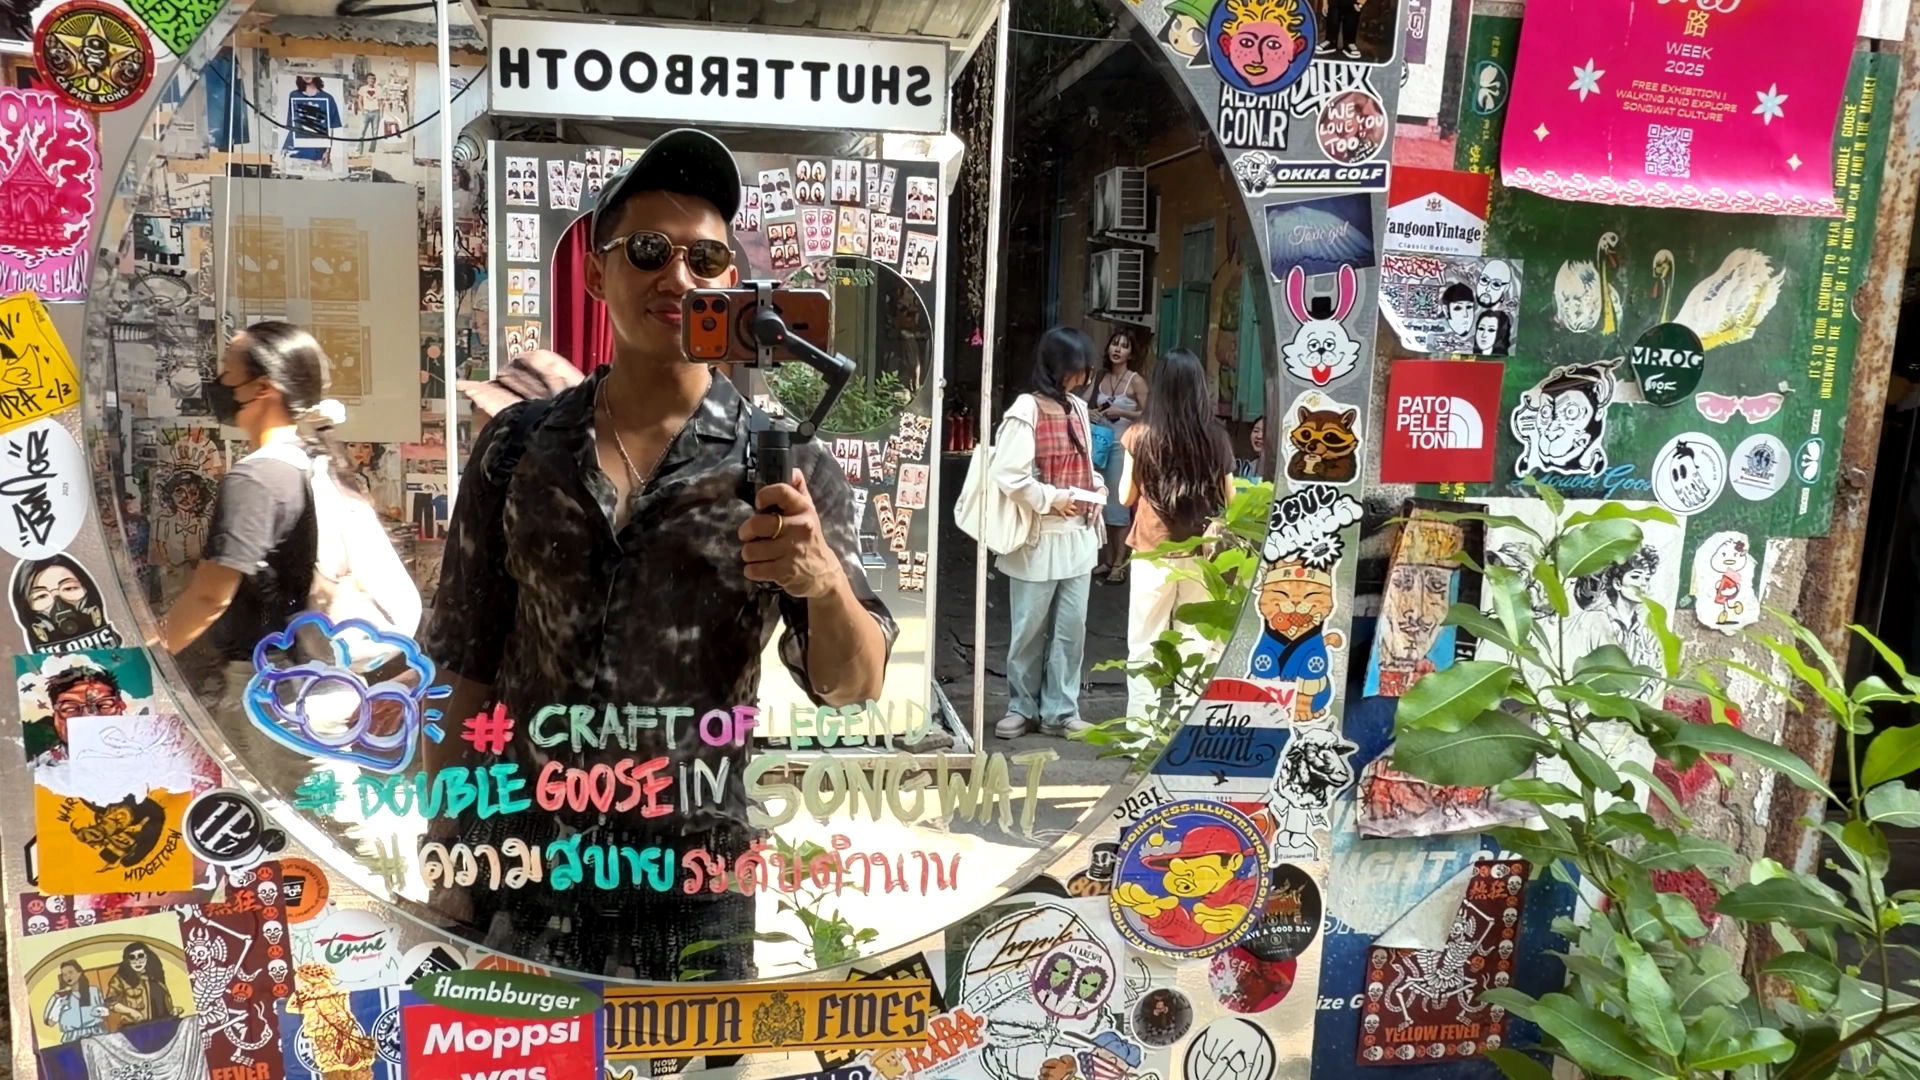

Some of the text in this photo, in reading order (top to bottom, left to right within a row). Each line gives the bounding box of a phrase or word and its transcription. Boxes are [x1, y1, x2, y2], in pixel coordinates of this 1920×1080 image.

[1683, 9, 1710, 38] 路
[1666, 41, 1713, 60] WEEK
[1664, 60, 1705, 77] 2025
[99, 88, 130, 104] KONG
[1631, 80, 1659, 91] FREE
[1660, 84, 1721, 100] EXHIBITION
[1859, 75, 1877, 113] MARKET
[1616, 89, 1738, 113] WALKING AND EXPLORE
[1622, 101, 1724, 122] SONGWAT CULTURE
[1320, 120, 1355, 135] LOVE
[1855, 122, 1869, 137] THE
[1854, 142, 1866, 151] IN
[1277, 168, 1383, 181] OKKA GOLF
[1851, 156, 1865, 177] FIND
[1847, 184, 1861, 201] CAN
[1842, 206, 1857, 223] YOU
[1328, 221, 1349, 245] girl
[1826, 222, 1841, 247] WEAR
[1840, 228, 1855, 249] KIND
[1398, 242, 1459, 252] Classic Reborn
[1823, 254, 1836, 265] TO
[1817, 272, 1834, 311] COMFORT
[1834, 281, 1847, 292] OF
[1831, 298, 1845, 319] BEST
[1813, 318, 1828, 339] YOUR
[1829, 326, 1841, 340] THE
[1812, 344, 1824, 356] TO
[1821, 347, 1838, 399] UNDERWEAR
[1398, 396, 1450, 414] PATO
[1397, 414, 1448, 431] PELE
[1409, 432, 1448, 449] TON
[1603, 464, 1652, 500] Goos
[1204, 703, 1251, 737] The
[536, 756, 675, 818] GOOSE
[679, 756, 730, 818] IN
[743, 749, 1058, 838] SONGWAT
[1271, 925, 1292, 933] GOOD
[1295, 925, 1312, 933] DAY
[432, 976, 580, 1012] flambburger
[813, 989, 926, 1041] FIDES
[422, 1015, 580, 1059] Moppsi
[1385, 1024, 1481, 1043] YELLOW FEVER
[905, 1027, 984, 1074] KAPE
[653, 1059, 677, 1067] NOW
[654, 1066, 678, 1074] NOW
